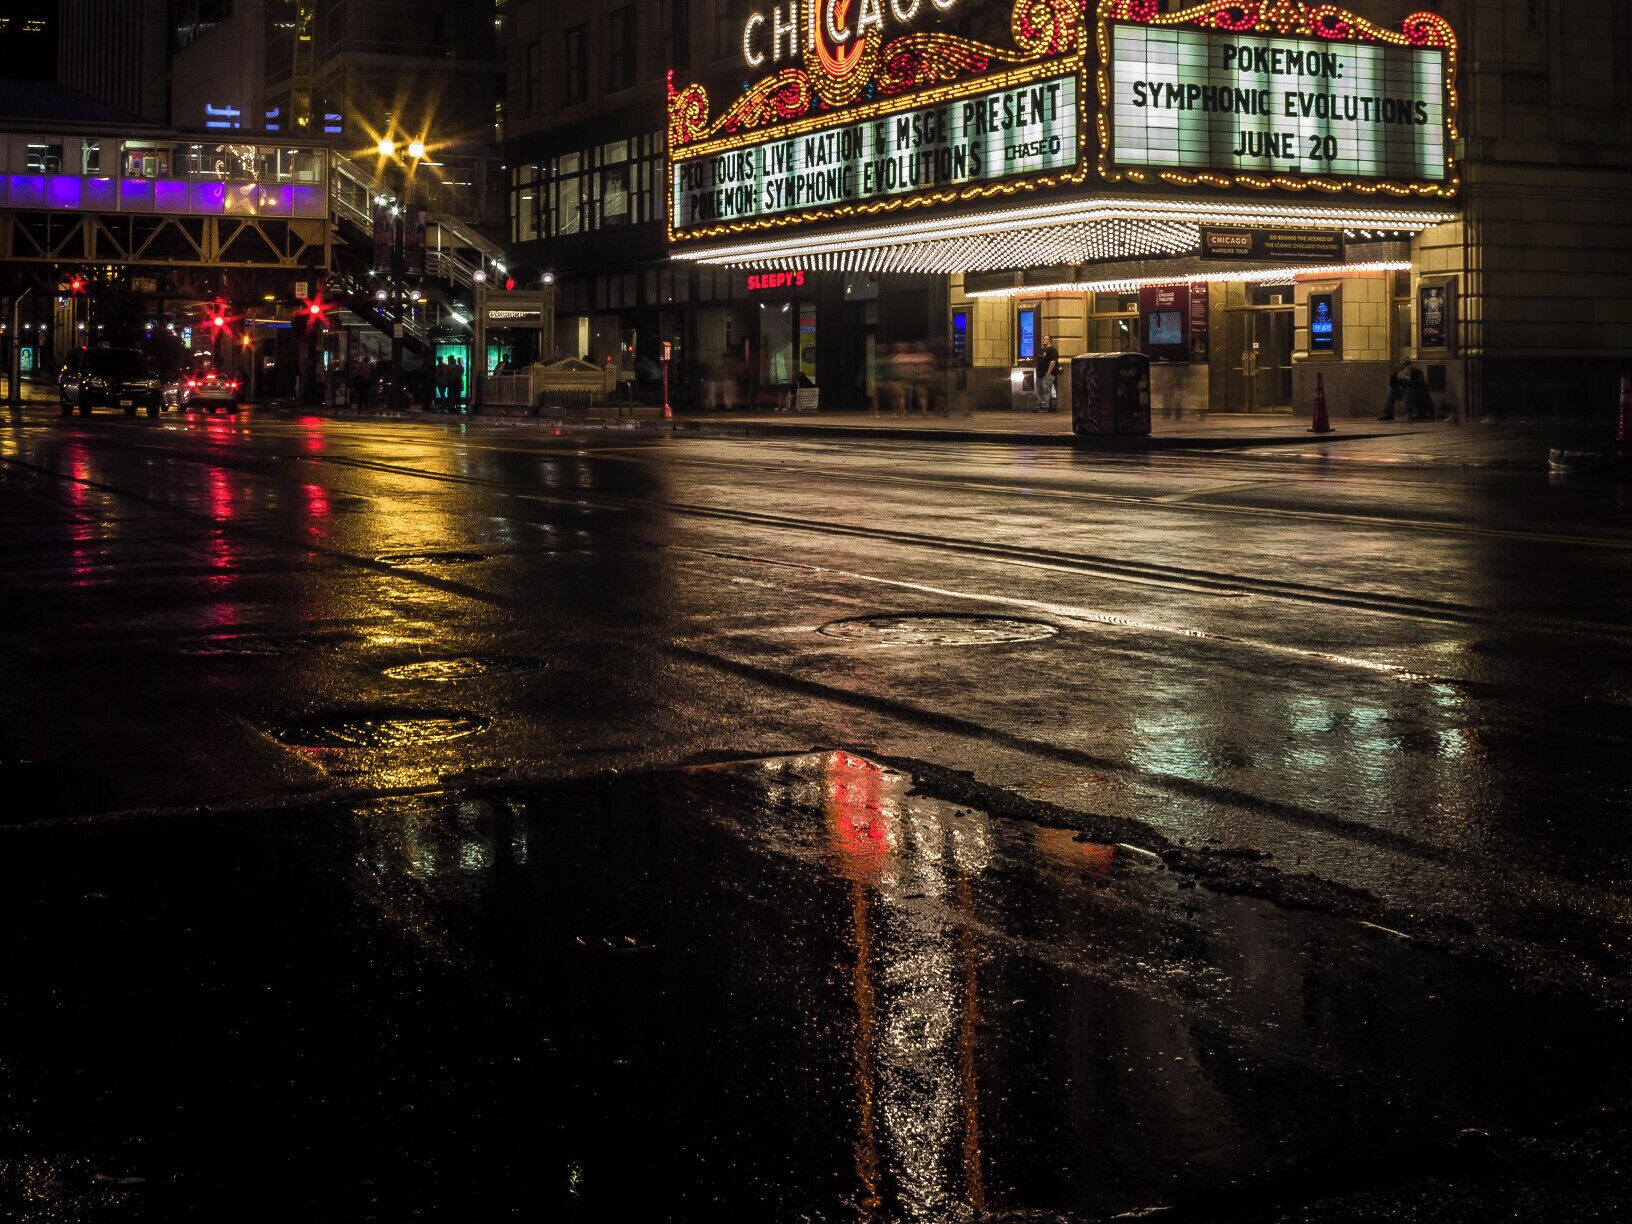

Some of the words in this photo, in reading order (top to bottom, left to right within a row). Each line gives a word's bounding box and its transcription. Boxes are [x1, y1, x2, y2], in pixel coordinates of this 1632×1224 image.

[1223, 44, 1344, 79] POKEMON:
[1132, 80, 1271, 117] SYMPHONIC
[1284, 91, 1429, 126] EVOLUTIONS
[710, 150, 757, 187] TOURS,
[763, 141, 795, 176] LIVE
[805, 127, 863, 168] NATION
[874, 122, 886, 155] &
[897, 108, 948, 151] MSGE
[962, 83, 1061, 138] PRESENT
[1004, 138, 1048, 161] CHASE
[1233, 131, 1295, 160] JUNE
[1308, 135, 1338, 161] 20
[691, 184, 758, 222] POKEMON:
[765, 165, 852, 210] SYMPHONIC
[863, 140, 982, 194] EVOLUTIONS
[1211, 236, 1247, 245] CHICAGO
[747, 269, 805, 290] SLEEPY'S
